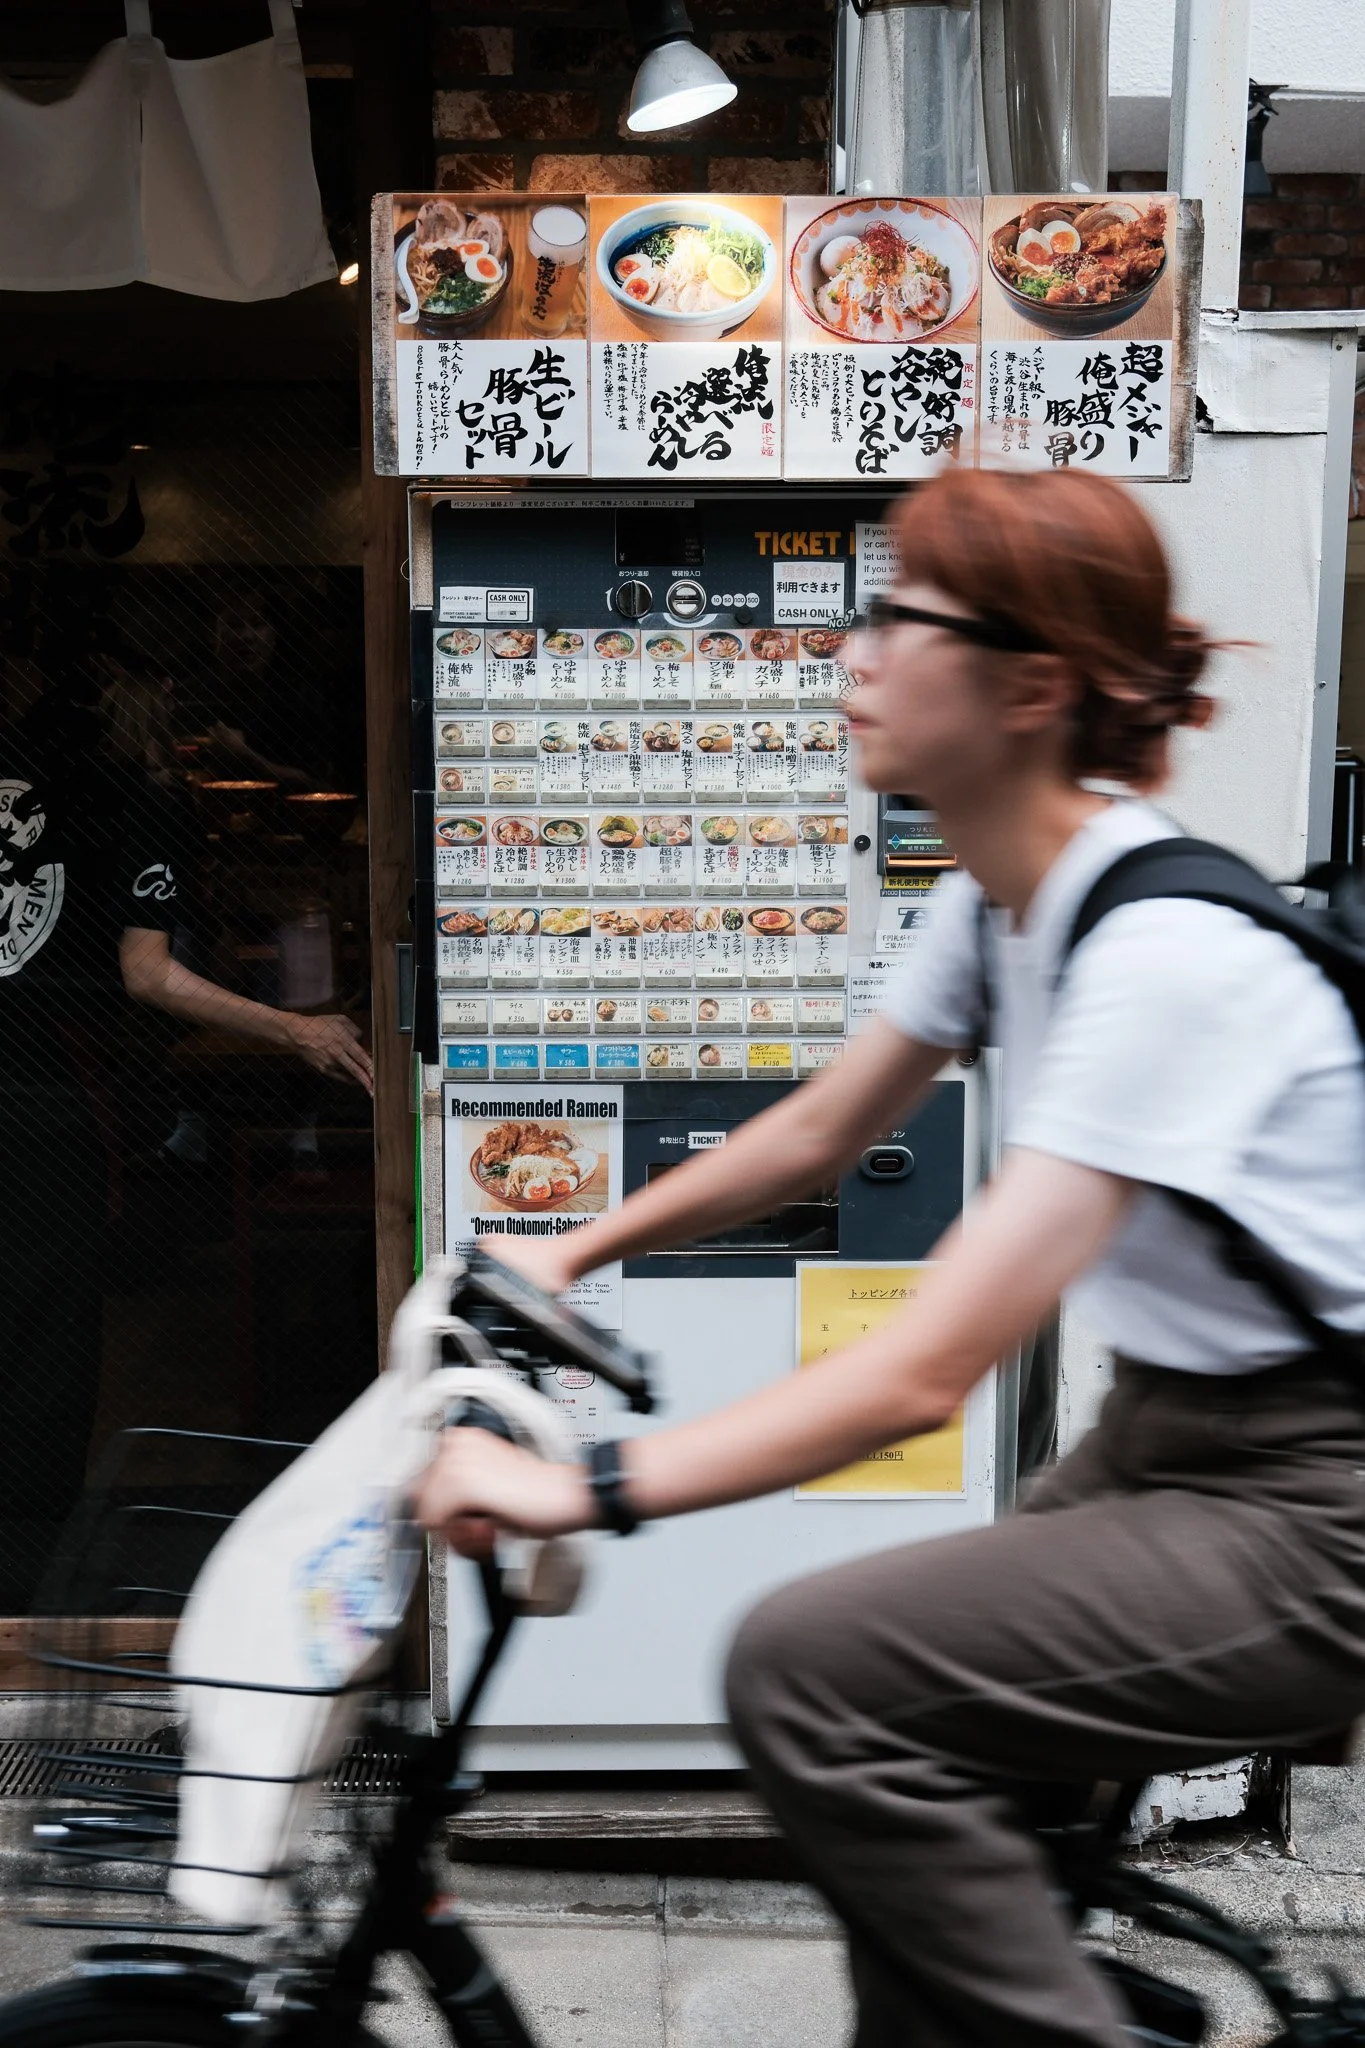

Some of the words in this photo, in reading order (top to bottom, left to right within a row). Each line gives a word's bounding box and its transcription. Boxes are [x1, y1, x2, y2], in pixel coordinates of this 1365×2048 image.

[732, 344, 774, 420] 俺流
[961, 362, 975, 409] 限定麺
[987, 351, 999, 428] くらいの旨さです。
[1029, 346, 1045, 400] メジャー級の
[526, 345, 576, 470] 生ビール
[889, 346, 928, 443] 冷やし
[917, 347, 963, 461] 絶好調
[1075, 351, 1119, 461] 俺盛り
[1117, 342, 1164, 463] 超メジャー
[483, 367, 537, 459] 豚骨
[648, 391, 680, 471] らーめん
[673, 381, 707, 459] 冷やし
[702, 367, 736, 461] 選べる
[856, 370, 900, 474] とりそば
[455, 399, 495, 470] セット
[1043, 399, 1083, 468] 豚骨
[755, 532, 842, 556] TICKET
[872, 529, 887, 539] you
[875, 540, 895, 548] can't
[782, 564, 836, 580] 現金のみ
[864, 553, 875, 561] let
[872, 567, 887, 576] you
[490, 594, 507, 602] CASH
[776, 582, 841, 594] 利用できます
[778, 609, 807, 618] CASH
[810, 609, 840, 618] ONLY
[551, 663, 562, 689] らーめん
[601, 663, 612, 688] らーめん
[653, 664, 665, 689] らーめん
[806, 664, 819, 686] 豚骨
[545, 849, 556, 874] らーめん
[452, 1098, 562, 1118] Recommended
[567, 1099, 618, 1118] Ramen
[692, 1136, 723, 1144] TICKET
